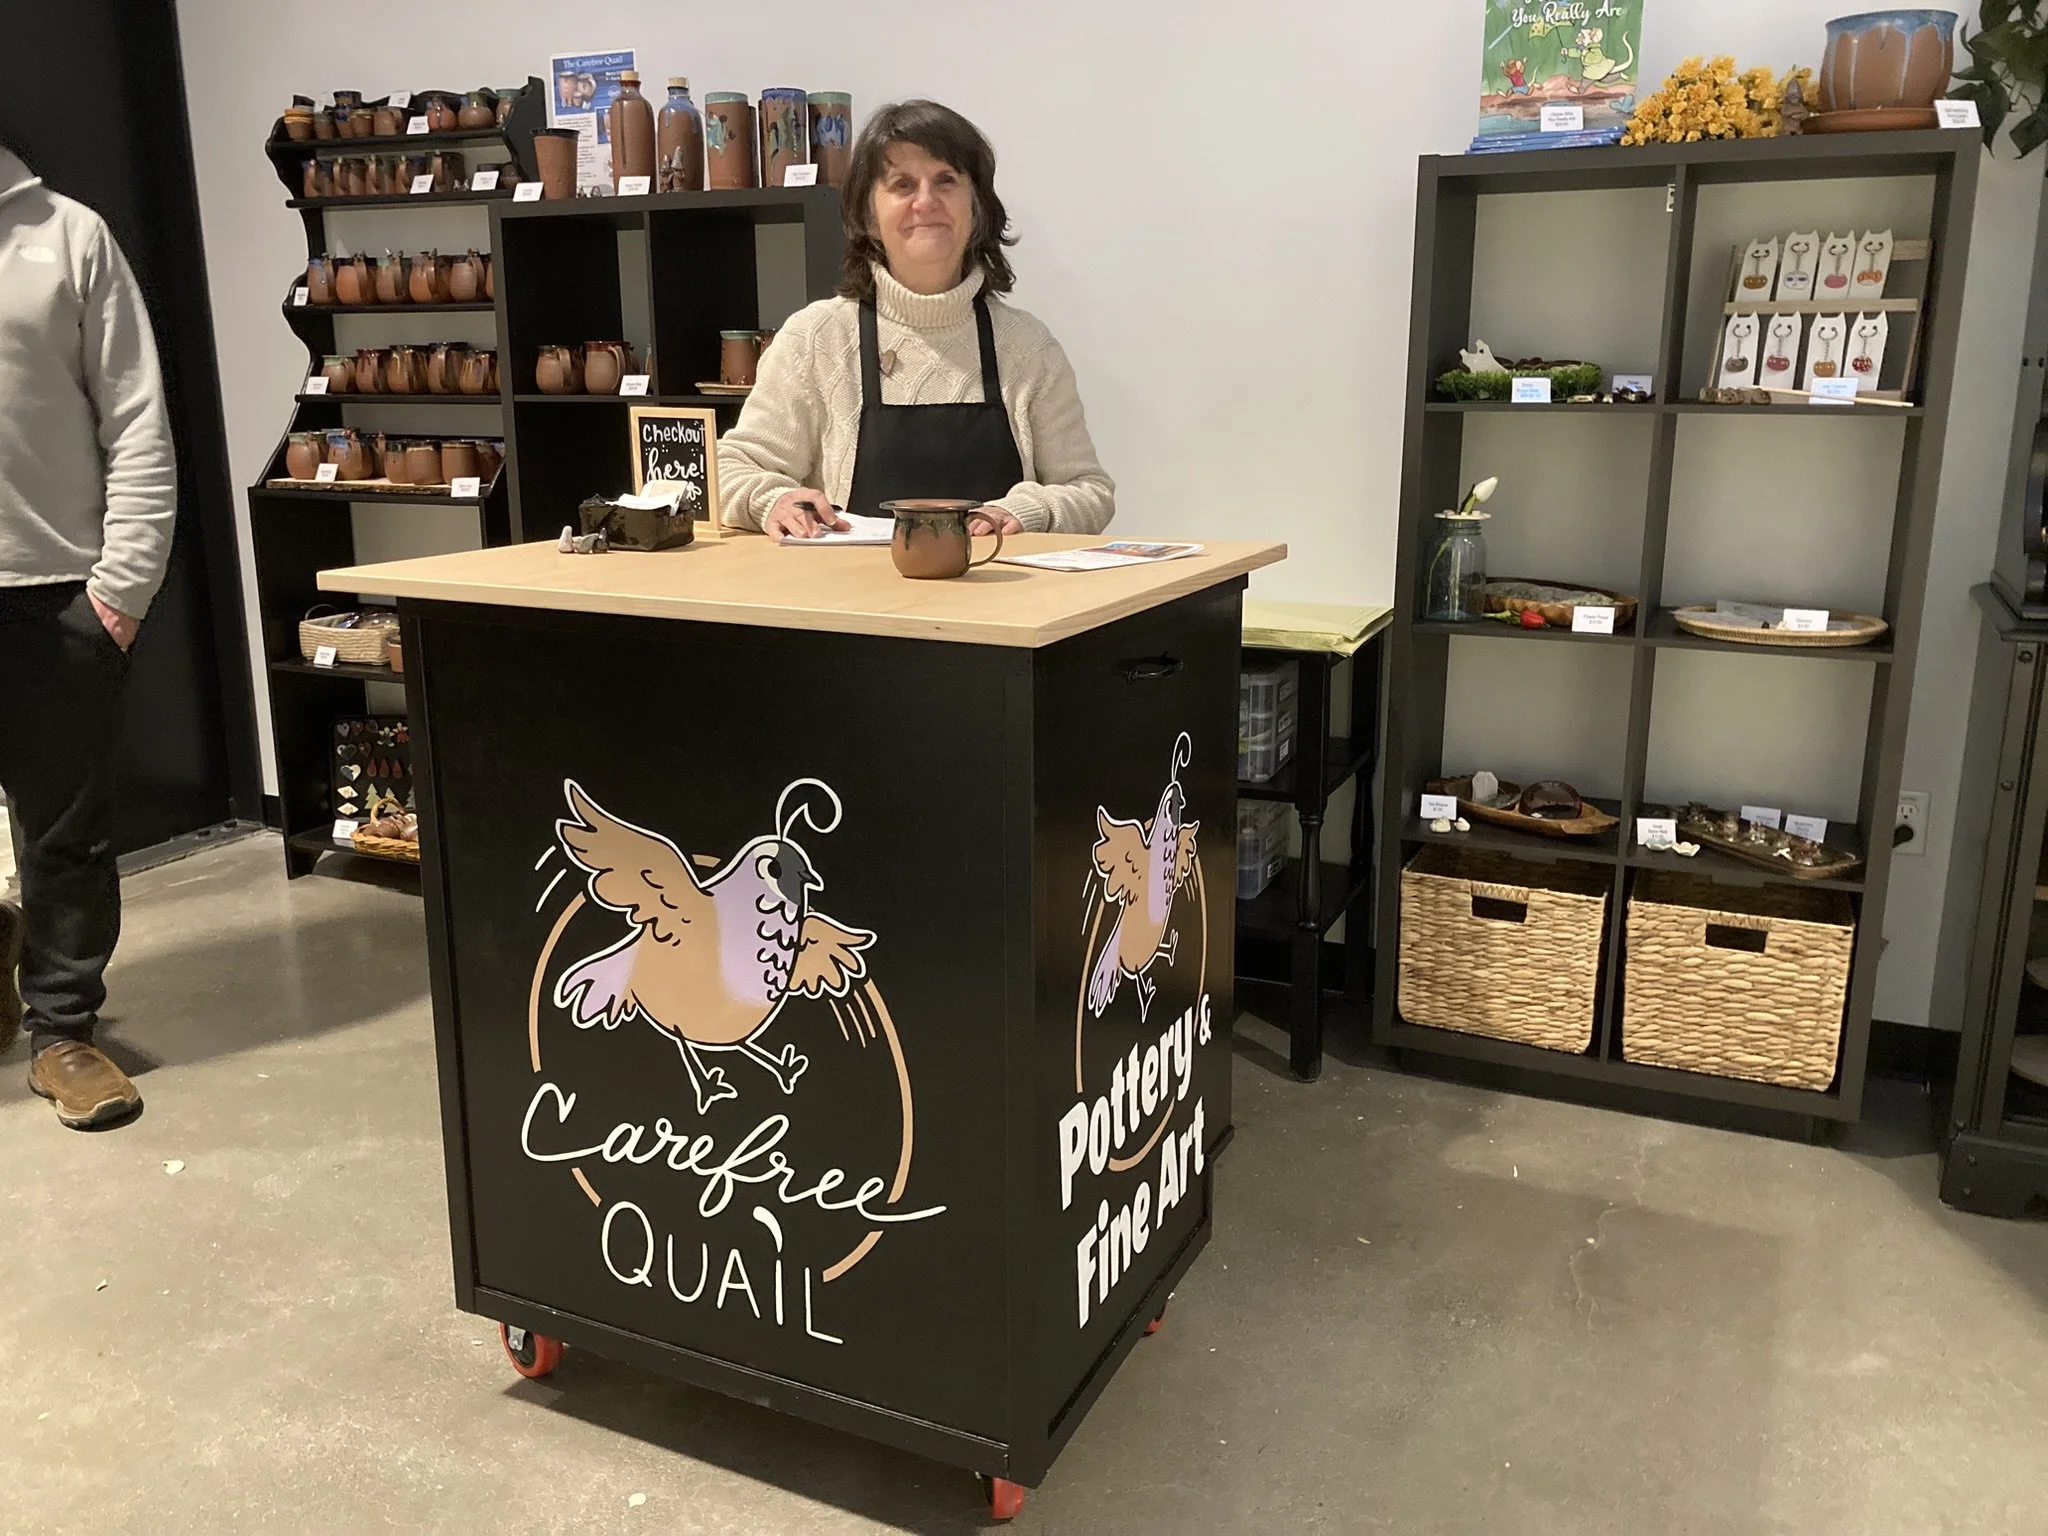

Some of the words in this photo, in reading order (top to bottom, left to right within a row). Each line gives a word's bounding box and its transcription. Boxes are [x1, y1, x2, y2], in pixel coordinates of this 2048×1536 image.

[1512, 7, 1537, 28] You
[1543, 1, 1590, 26] Really
[1595, 0, 1622, 18] Are
[647, 447, 705, 482] here!
[521, 1083, 947, 1218] Carefree
[1059, 1006, 1193, 1211] Pottery
[1199, 993, 1213, 1046] &
[1077, 1199, 1150, 1330] Fine
[1157, 1096, 1205, 1230] Art
